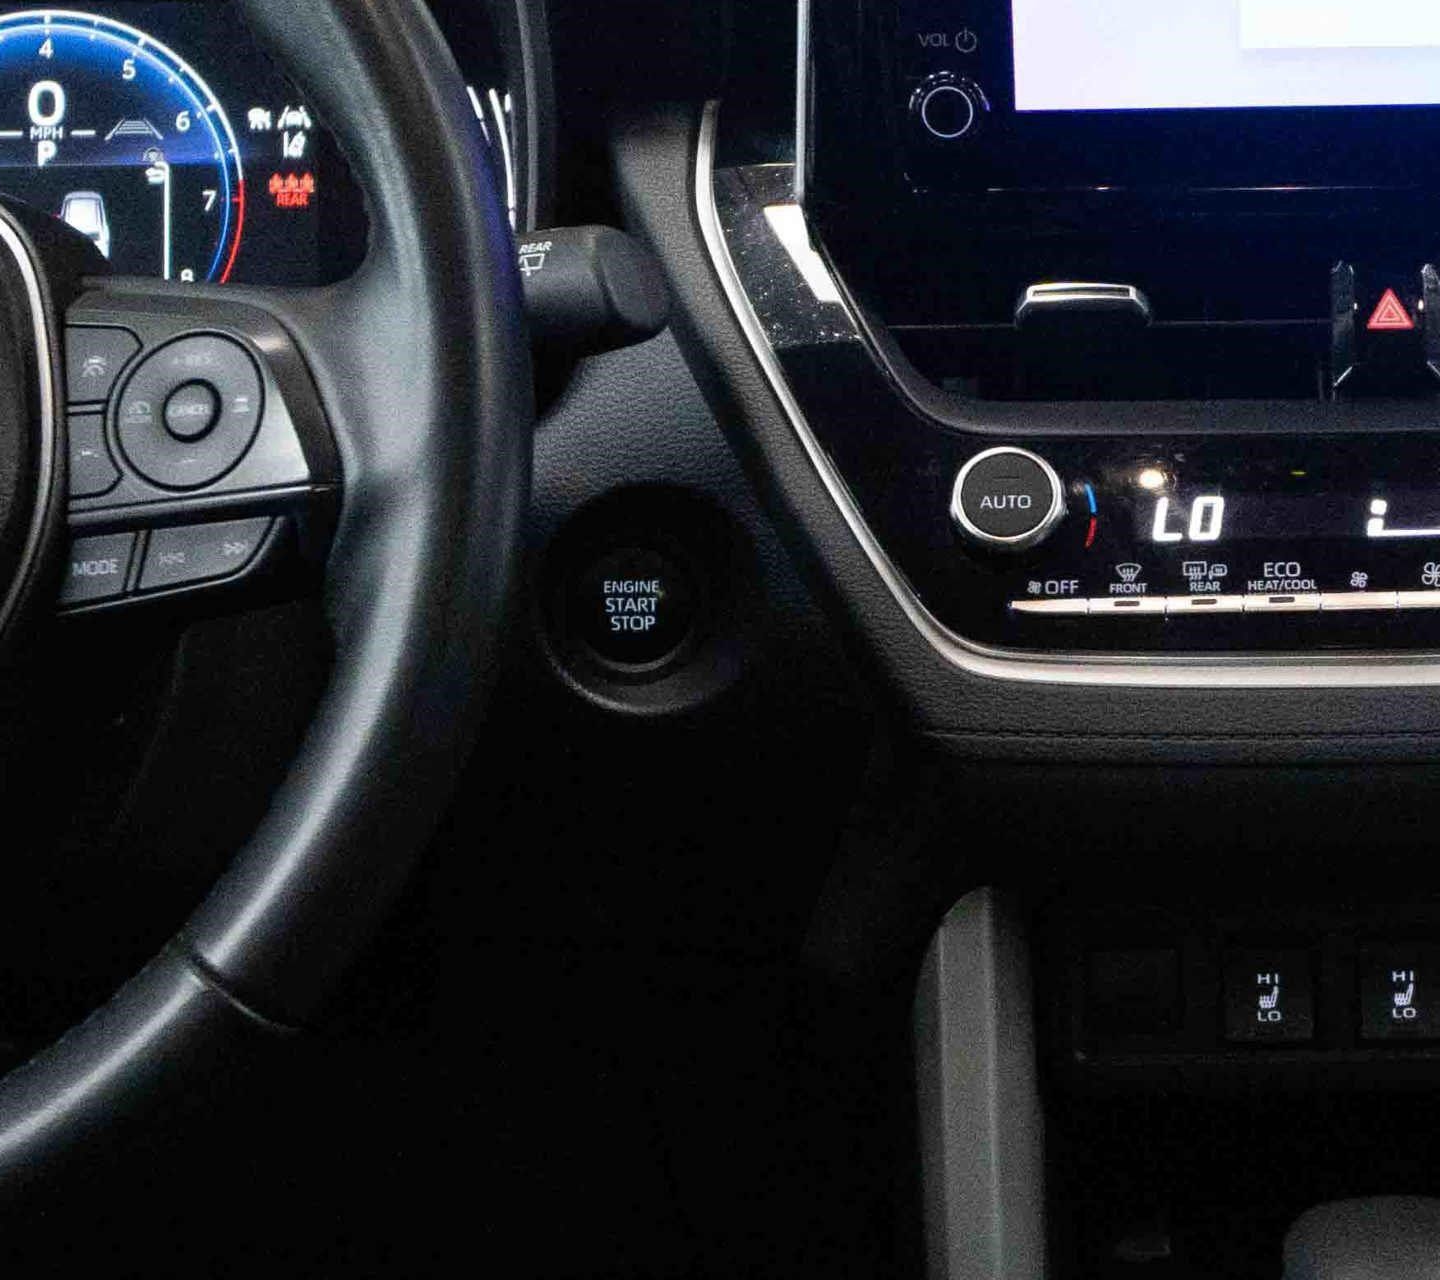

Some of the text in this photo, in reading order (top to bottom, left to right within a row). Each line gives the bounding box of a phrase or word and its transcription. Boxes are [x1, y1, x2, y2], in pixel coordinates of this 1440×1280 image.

[917, 32, 950, 48] VOL
[38, 39, 54, 59] 4
[122, 59, 137, 81] 5
[28, 80, 66, 127] 0
[175, 111, 191, 132] 6
[29, 126, 64, 141] MPH
[37, 141, 57, 167] P
[202, 191, 216, 212] 7
[277, 193, 308, 207] REAR
[518, 241, 553, 255] REAR
[980, 494, 1032, 509] AUTO
[1152, 495, 1225, 542] LO
[72, 558, 119, 577] MODE
[1263, 562, 1302, 578] ECO
[603, 580, 660, 593] ENGINE
[1045, 580, 1080, 595] OFF
[1109, 582, 1148, 594] FRONT
[1189, 581, 1221, 592] REAR
[1248, 578, 1318, 591] HEAT/COOL
[605, 597, 658, 612] START
[610, 615, 656, 631] STOP
[1256, 973, 1279, 984] HI
[1392, 970, 1415, 982] HI
[1257, 1010, 1282, 1022] LO
[1392, 1007, 1417, 1019] LO
